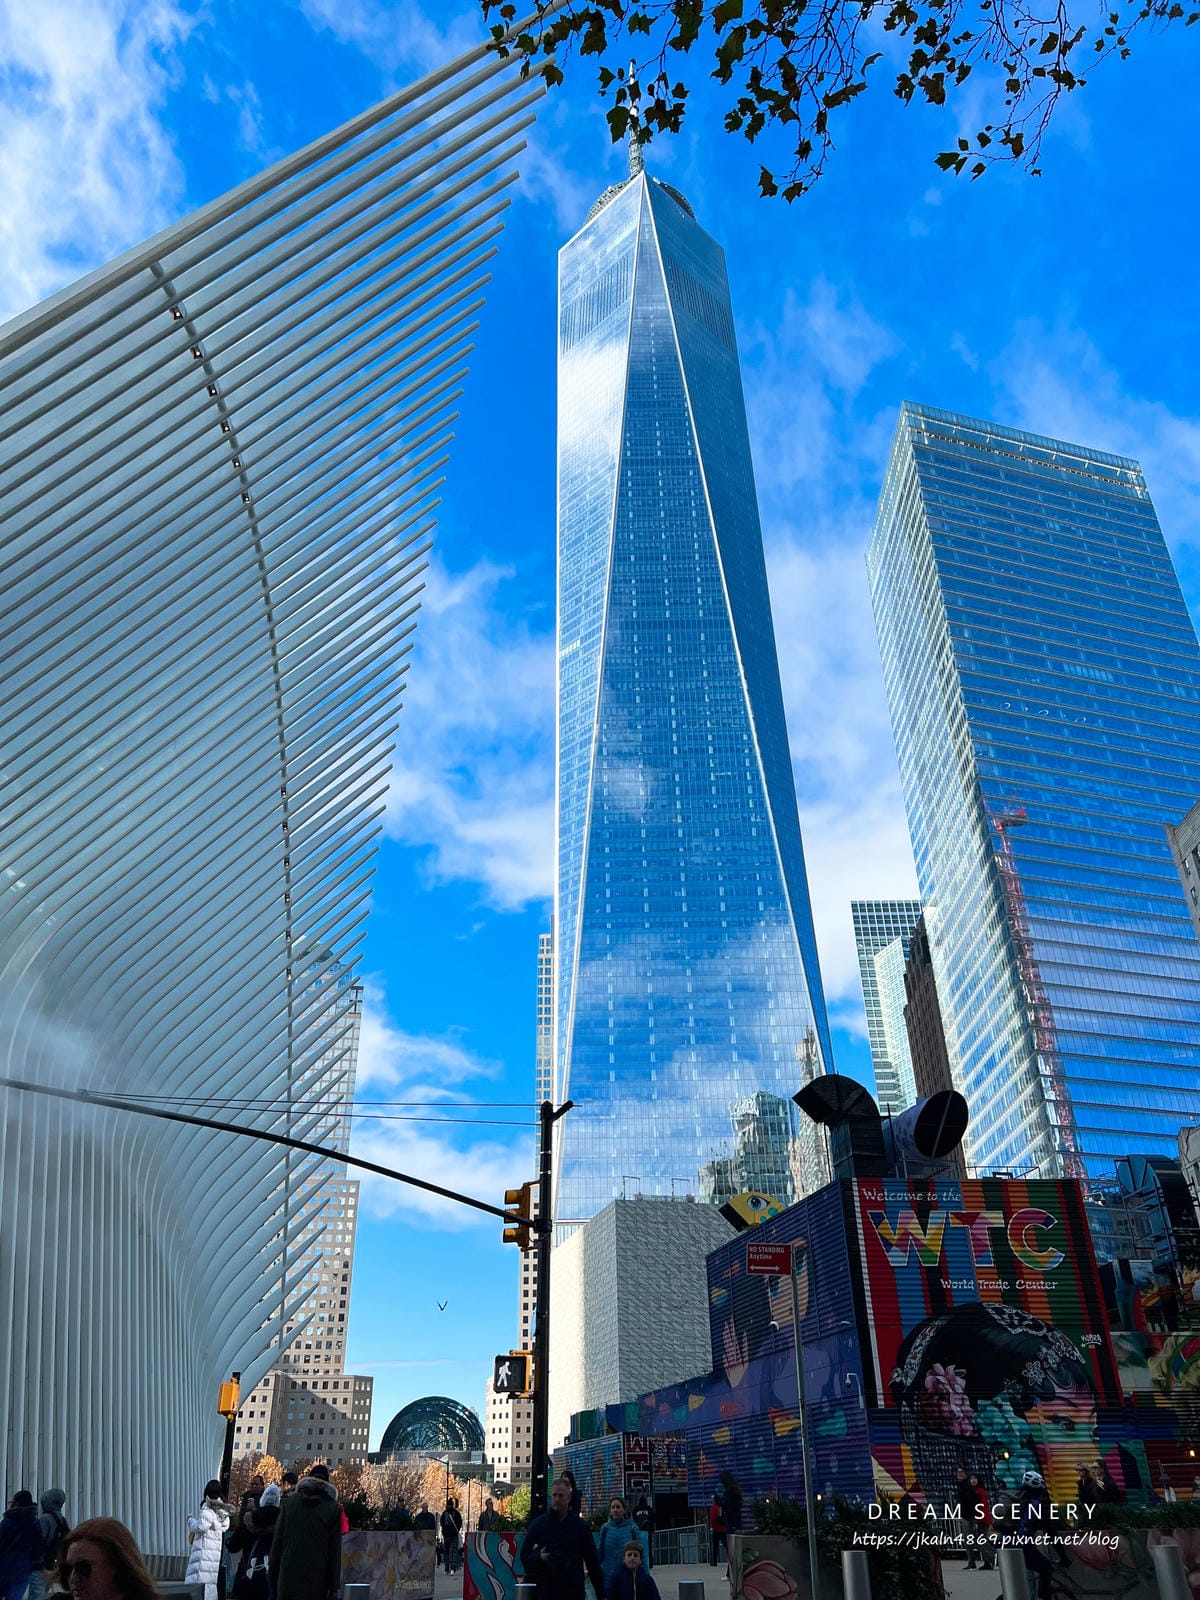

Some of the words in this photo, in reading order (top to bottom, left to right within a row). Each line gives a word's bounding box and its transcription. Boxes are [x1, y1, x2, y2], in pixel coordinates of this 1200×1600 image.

[861, 1187, 923, 1202] Welcome
[927, 1189, 938, 1202] to
[942, 1187, 961, 1202] the
[866, 1207, 1065, 1271] WTC
[758, 1246, 785, 1254] STANDING
[749, 1252, 772, 1261] Anytime
[940, 1278, 974, 1290] World
[978, 1278, 1010, 1290] Trade
[1016, 1278, 1058, 1290] Center
